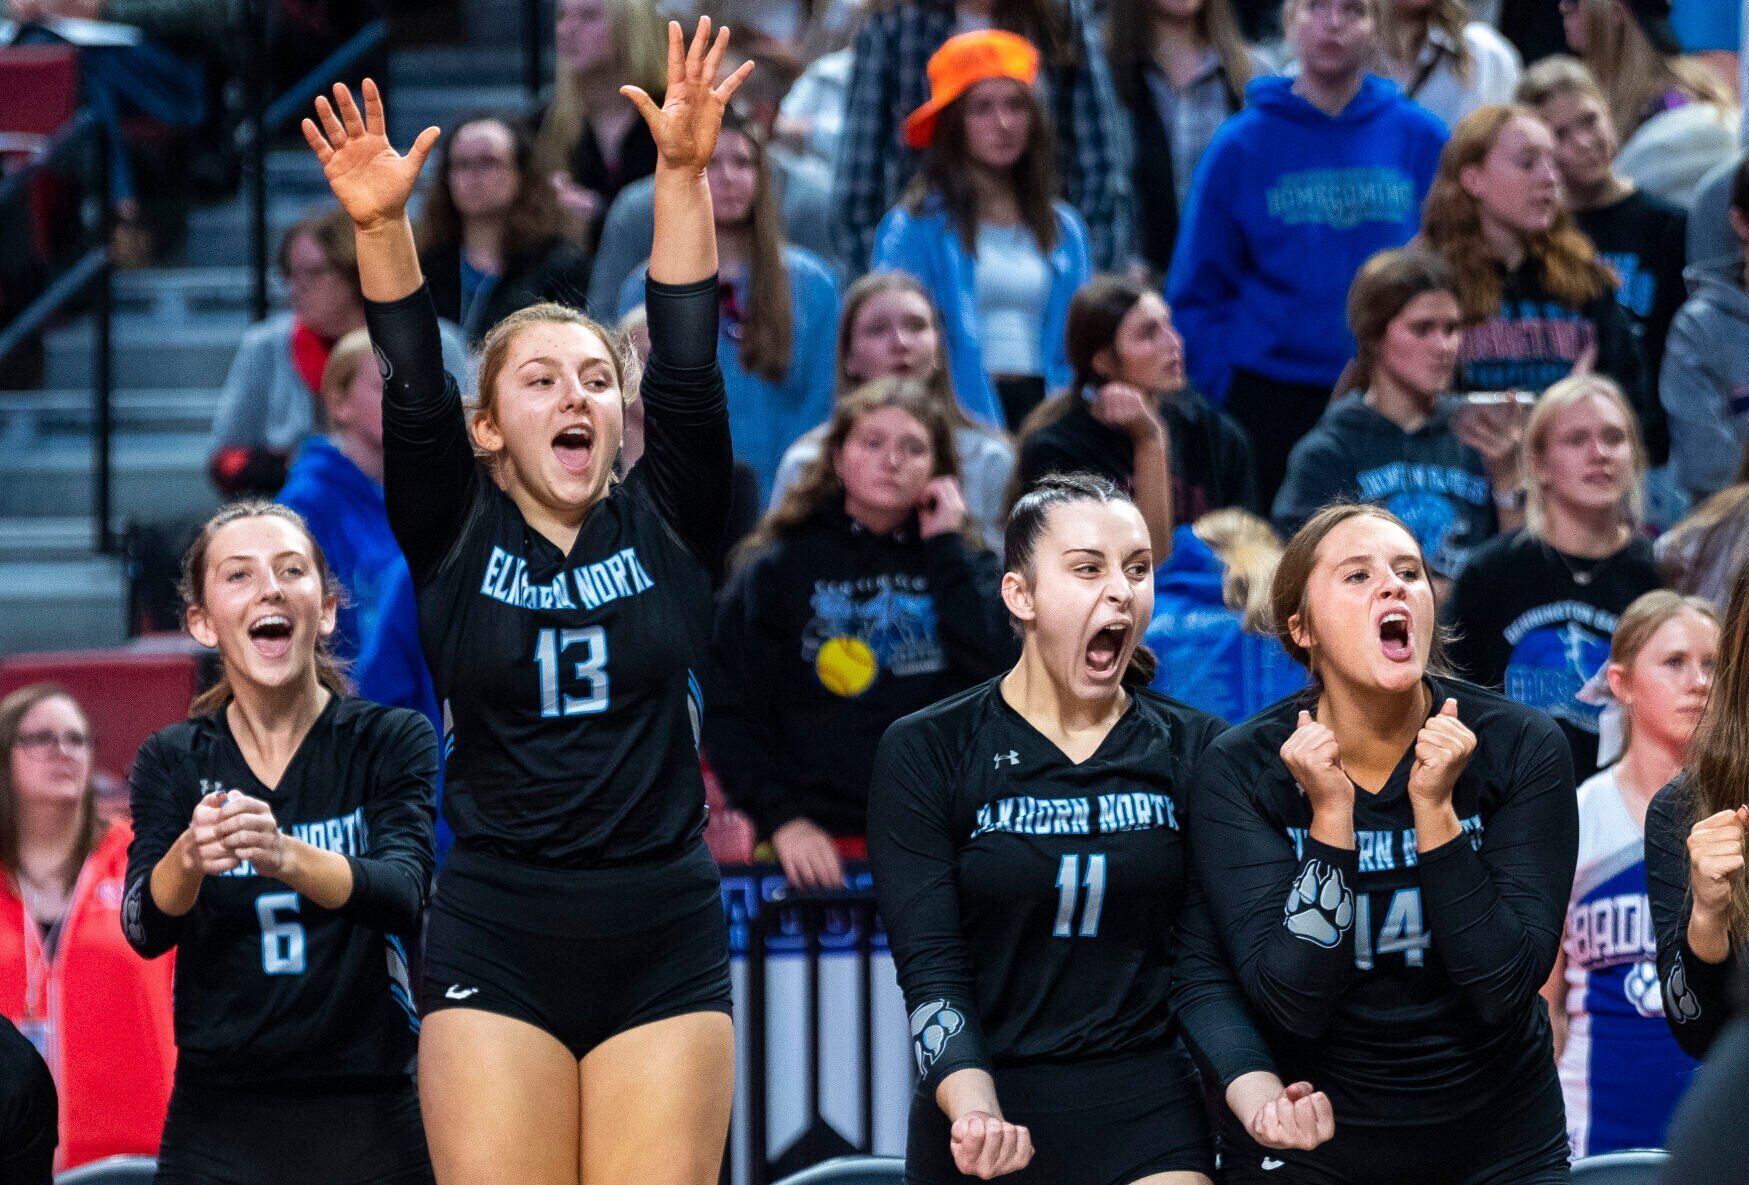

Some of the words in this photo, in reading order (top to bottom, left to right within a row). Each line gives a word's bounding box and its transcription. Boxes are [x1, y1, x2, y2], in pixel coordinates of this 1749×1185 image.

[533, 624, 609, 718] 13
[255, 891, 306, 976] 6
[1052, 853, 1106, 938] 11
[1354, 886, 1432, 971] 14
